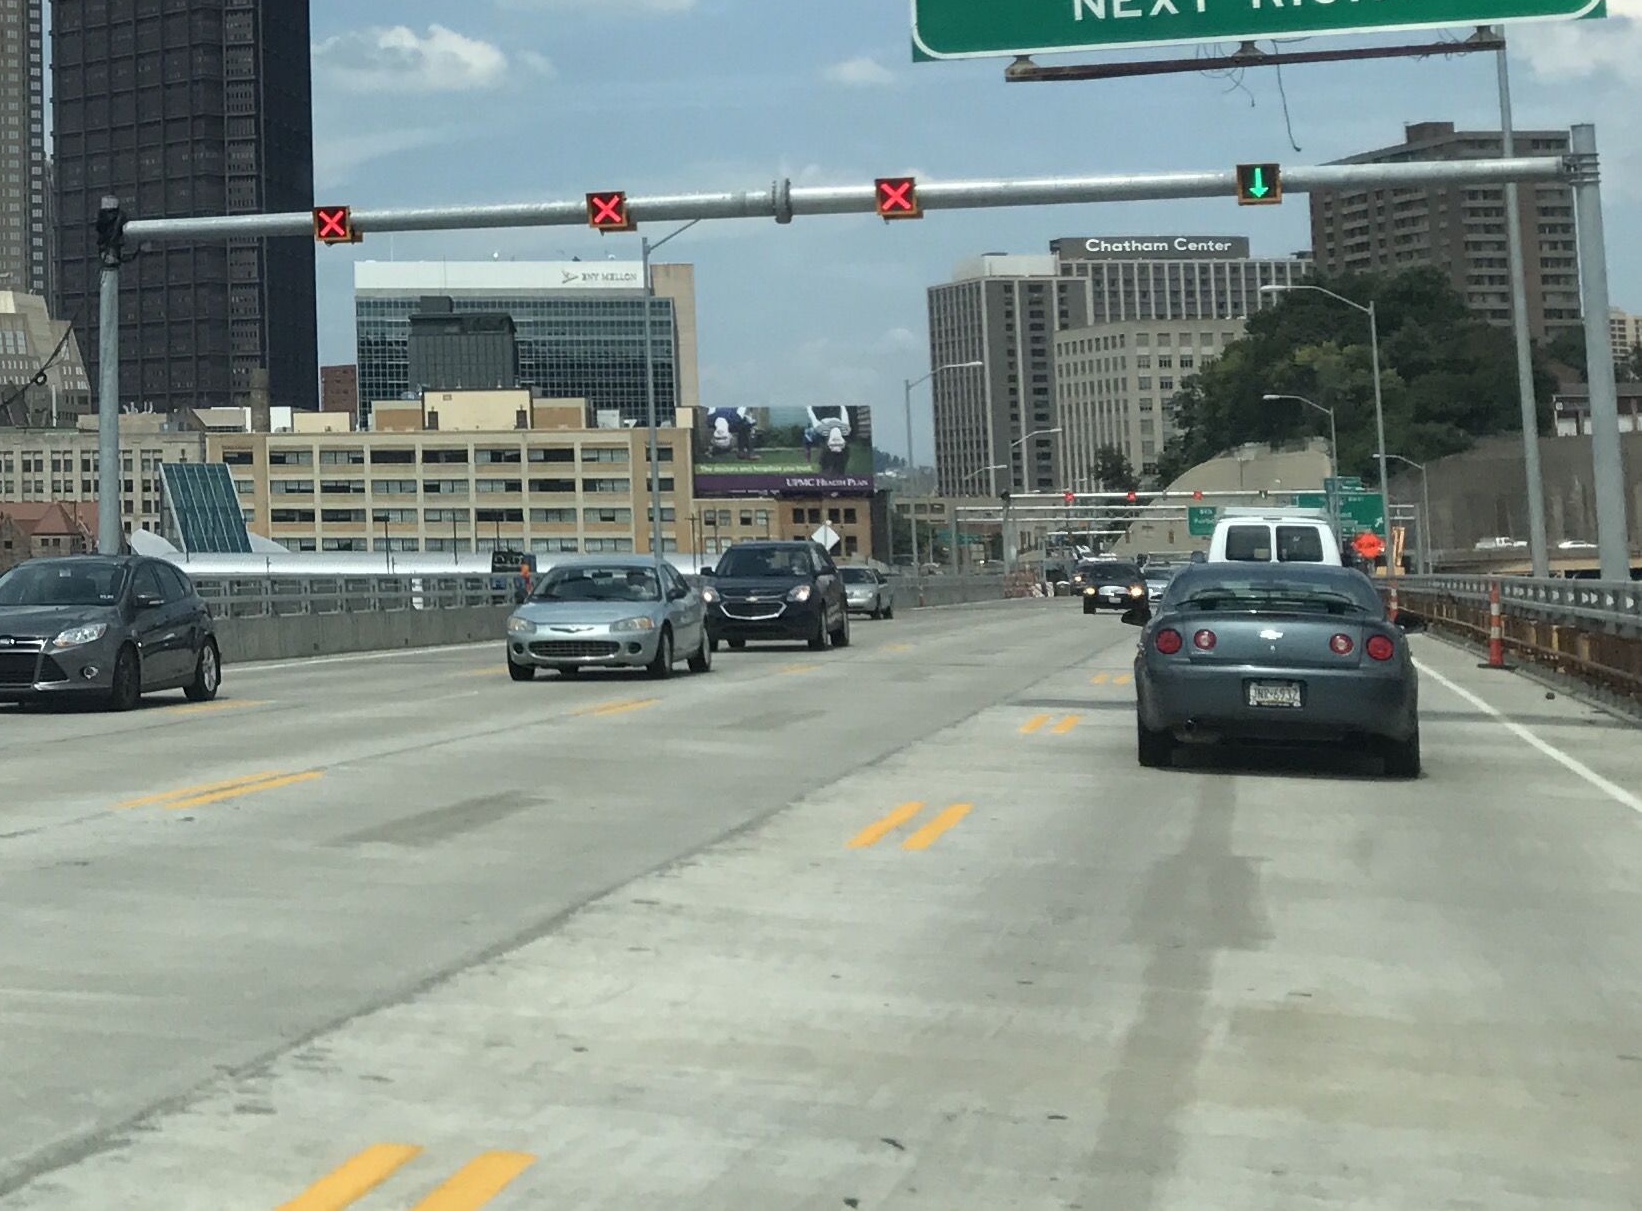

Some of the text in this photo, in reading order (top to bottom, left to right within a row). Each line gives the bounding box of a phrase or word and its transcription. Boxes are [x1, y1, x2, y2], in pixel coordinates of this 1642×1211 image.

[1085, 237, 1232, 252] Chatham Center
[601, 272, 637, 282] MELLON
[786, 478, 815, 488] UPMC
